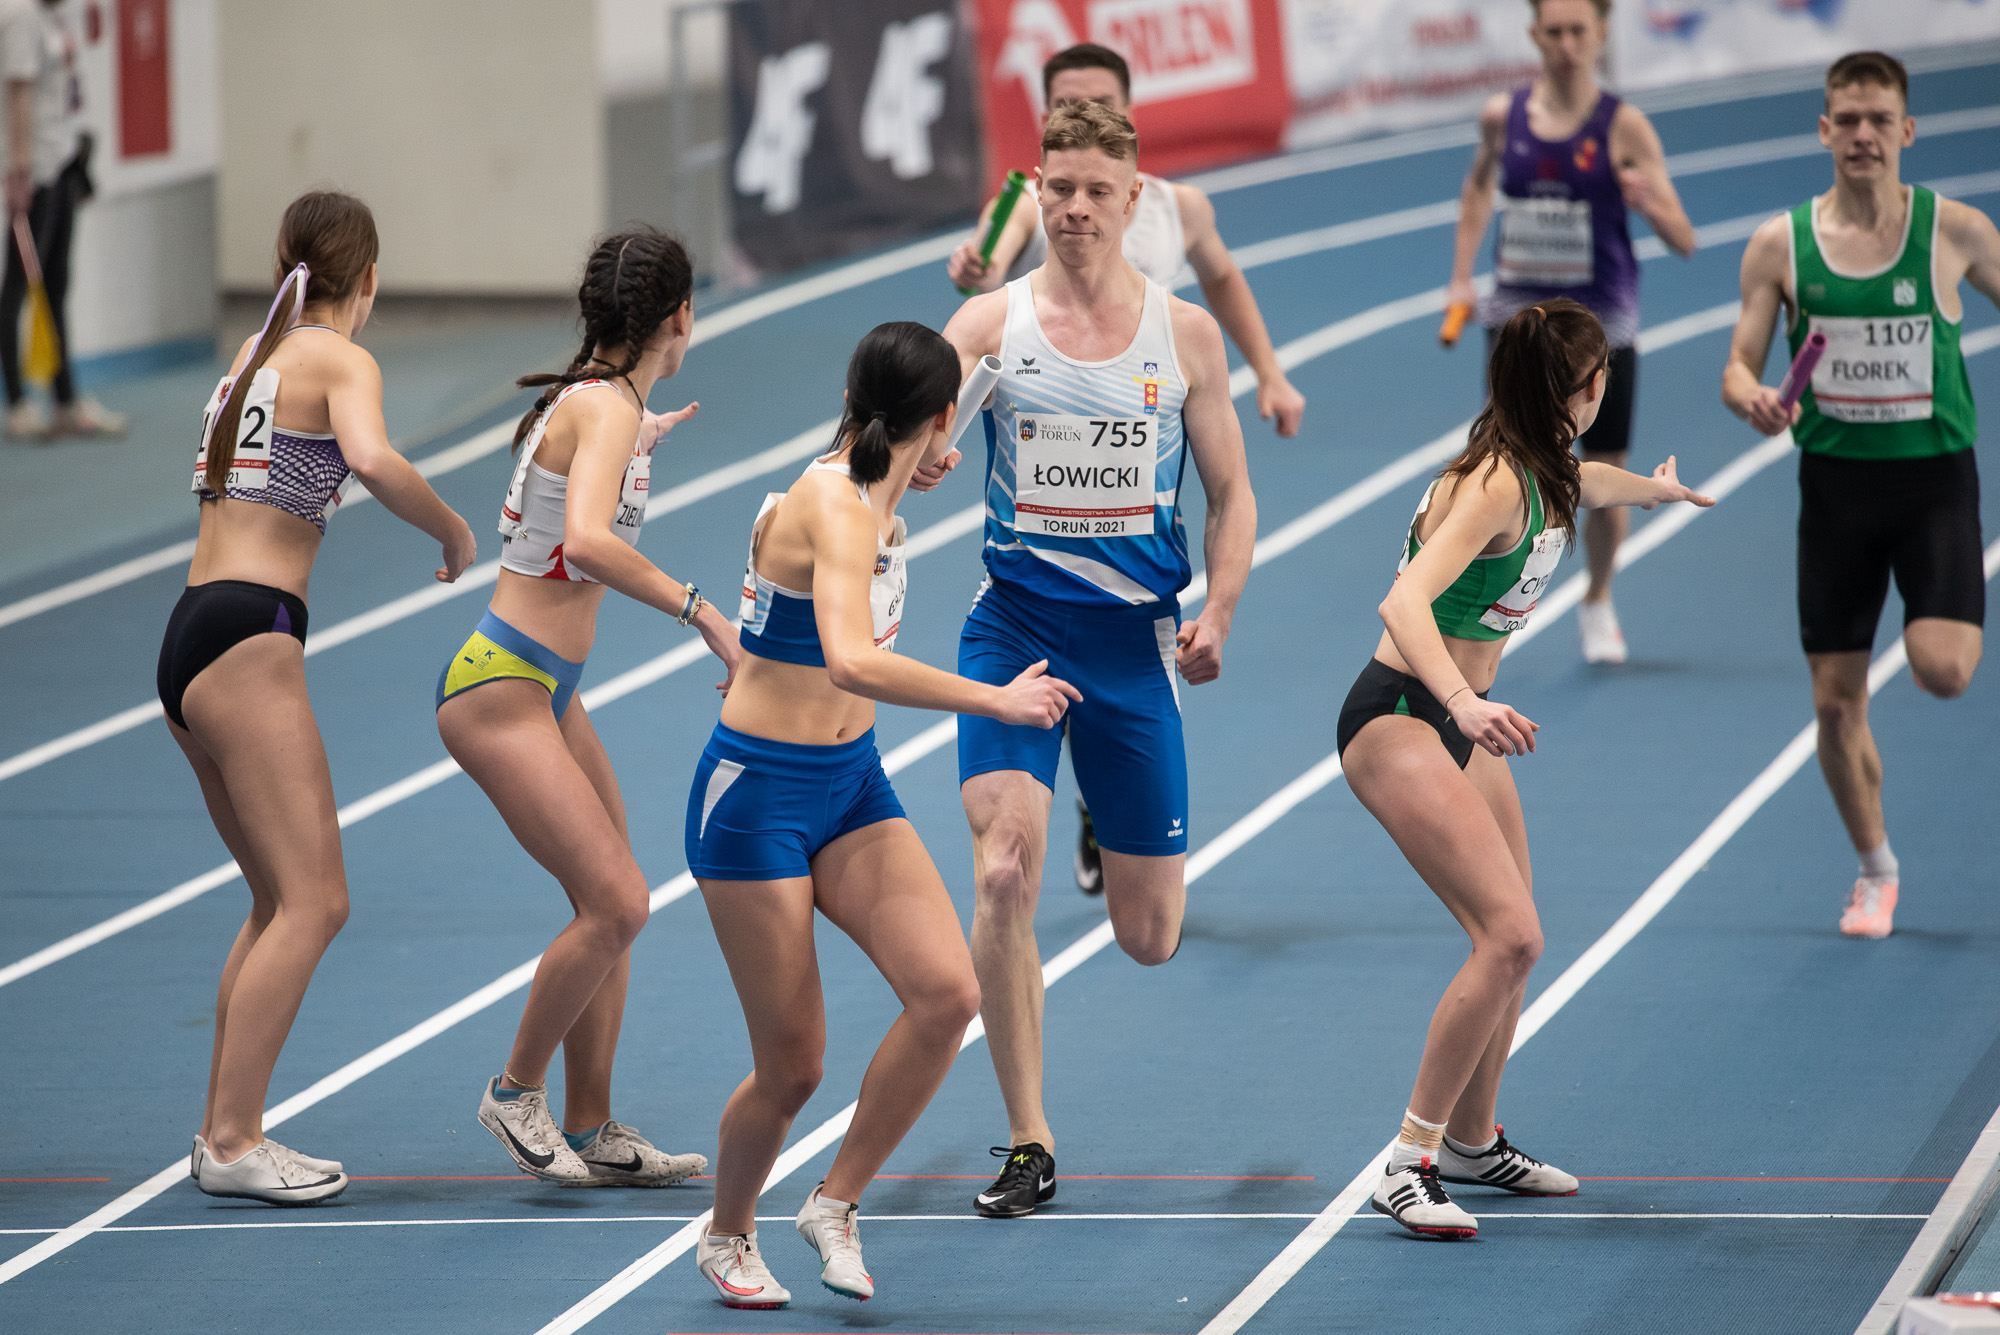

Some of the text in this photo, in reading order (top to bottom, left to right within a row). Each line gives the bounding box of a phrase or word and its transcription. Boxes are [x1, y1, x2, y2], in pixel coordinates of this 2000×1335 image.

[1865, 320, 1930, 347] 1107
[1015, 367, 1041, 375] erima
[1831, 359, 1910, 381] FLOREK
[1039, 429, 1082, 442] TORUŃ
[1041, 423, 1073, 431] MIASTO
[1089, 420, 1148, 449] 755
[1033, 463, 1139, 489] ŁOWICKI
[1042, 518, 1125, 534] TORUŃ 2021
